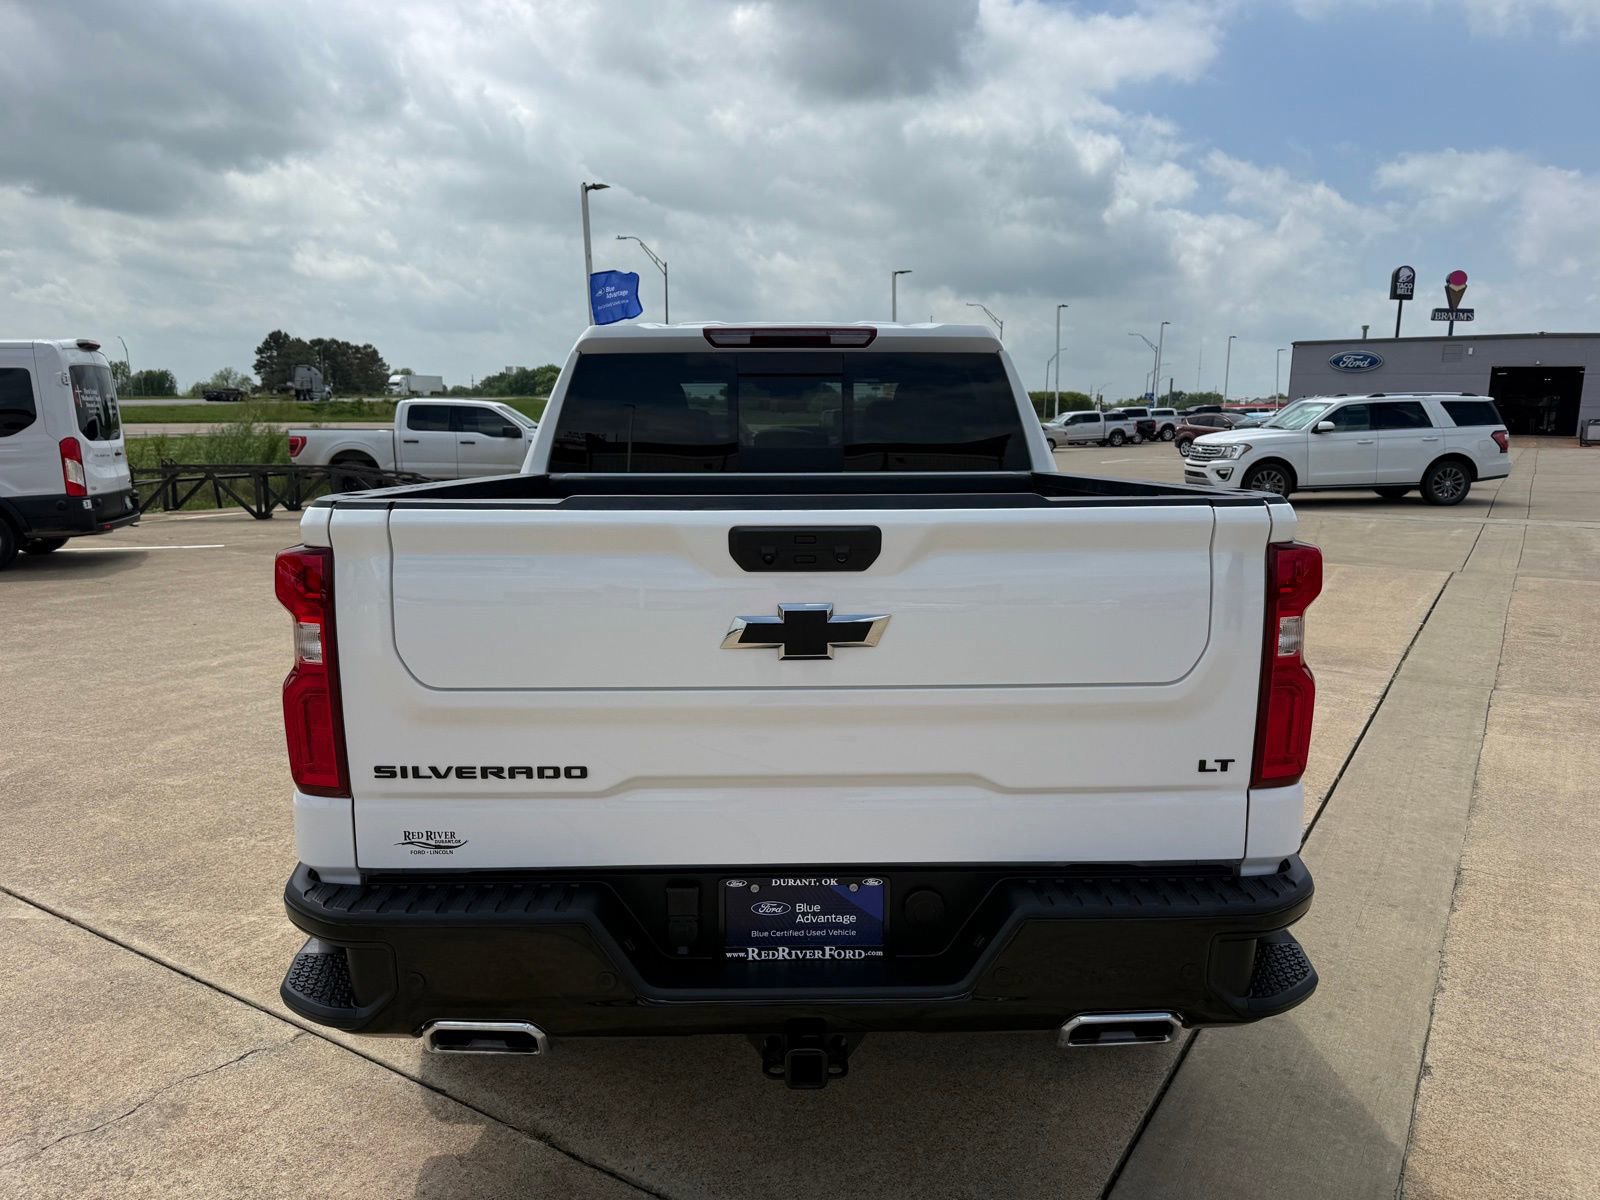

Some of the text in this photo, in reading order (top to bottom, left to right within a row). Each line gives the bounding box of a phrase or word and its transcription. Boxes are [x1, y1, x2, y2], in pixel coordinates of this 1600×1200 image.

[1435, 311, 1474, 321] BRAUM'S
[1339, 354, 1371, 368] Ford
[1198, 758, 1235, 772] LT
[373, 765, 588, 779] SILVERADO
[403, 830, 456, 841] RED RIVER
[772, 878, 839, 886] DURANT, OK
[758, 903, 784, 913] Ford
[795, 903, 821, 913] Blue
[795, 913, 857, 925] Advantage
[751, 930, 769, 938] Blue
[770, 929, 805, 937] Certified
[806, 929, 827, 937] Used
